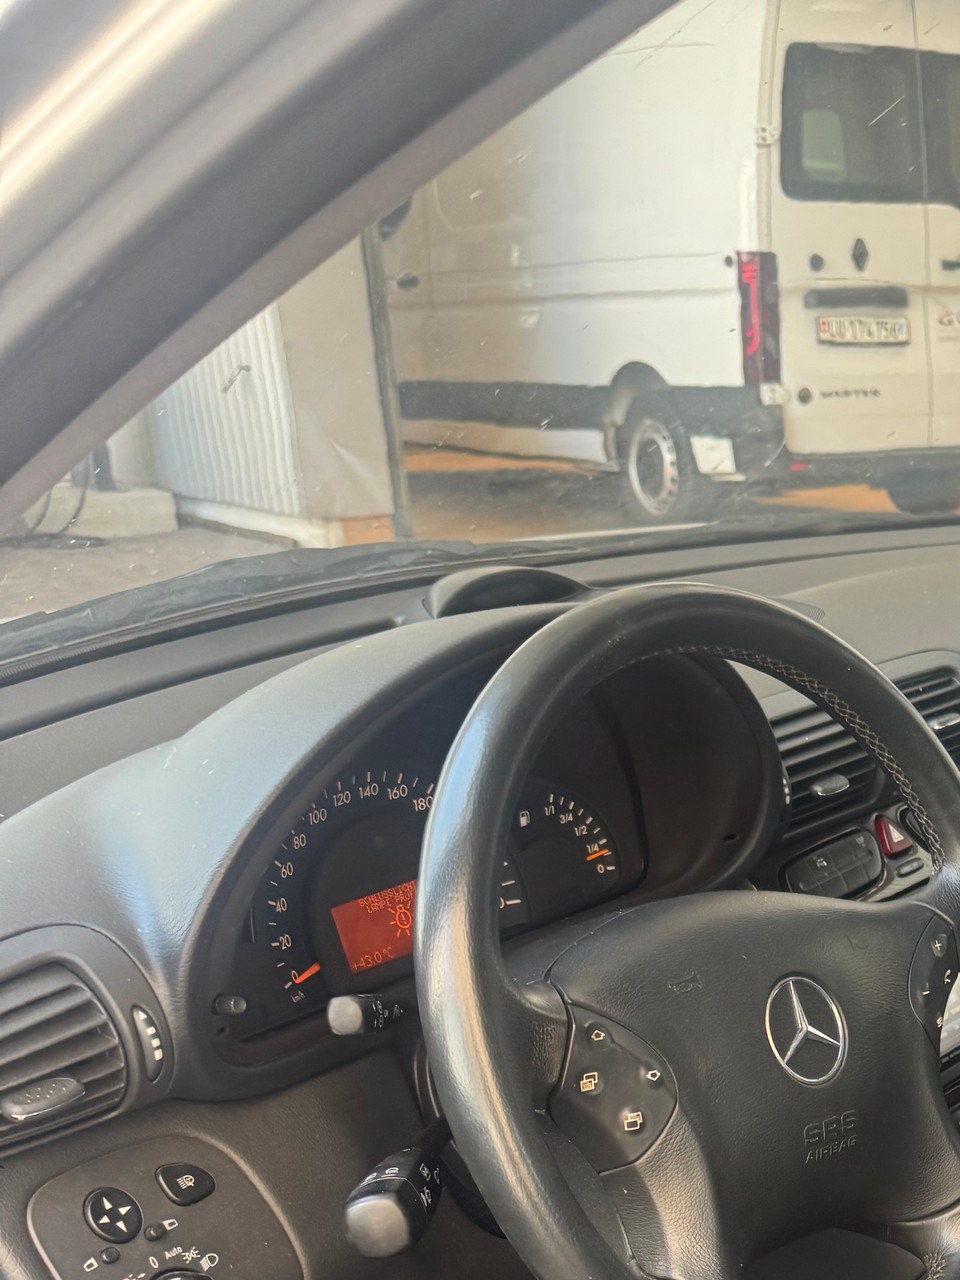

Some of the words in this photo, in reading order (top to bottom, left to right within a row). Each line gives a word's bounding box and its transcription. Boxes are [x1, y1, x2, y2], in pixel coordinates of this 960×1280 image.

[333, 791, 351, 807] 120
[359, 783, 379, 799] 140
[388, 784, 408, 800] 160
[309, 808, 327, 825] 100
[544, 805, 555, 816] 1/1
[560, 813, 573, 824] 3/4
[574, 825, 588, 837] 1/2
[293, 834, 307, 850] 80
[586, 843, 600, 854] 1/4
[281, 862, 294, 879] 60
[597, 864, 605, 873] 0
[275, 898, 288, 913] 40
[366, 897, 391, 914] LAMPE
[279, 934, 292, 950] 20
[291, 970, 299, 982] 0
[803, 1110, 857, 1144] SRS
[805, 1134, 858, 1164] AIRBAG
[164, 1246, 183, 1260] Auto
[149, 1256, 159, 1269] 0
